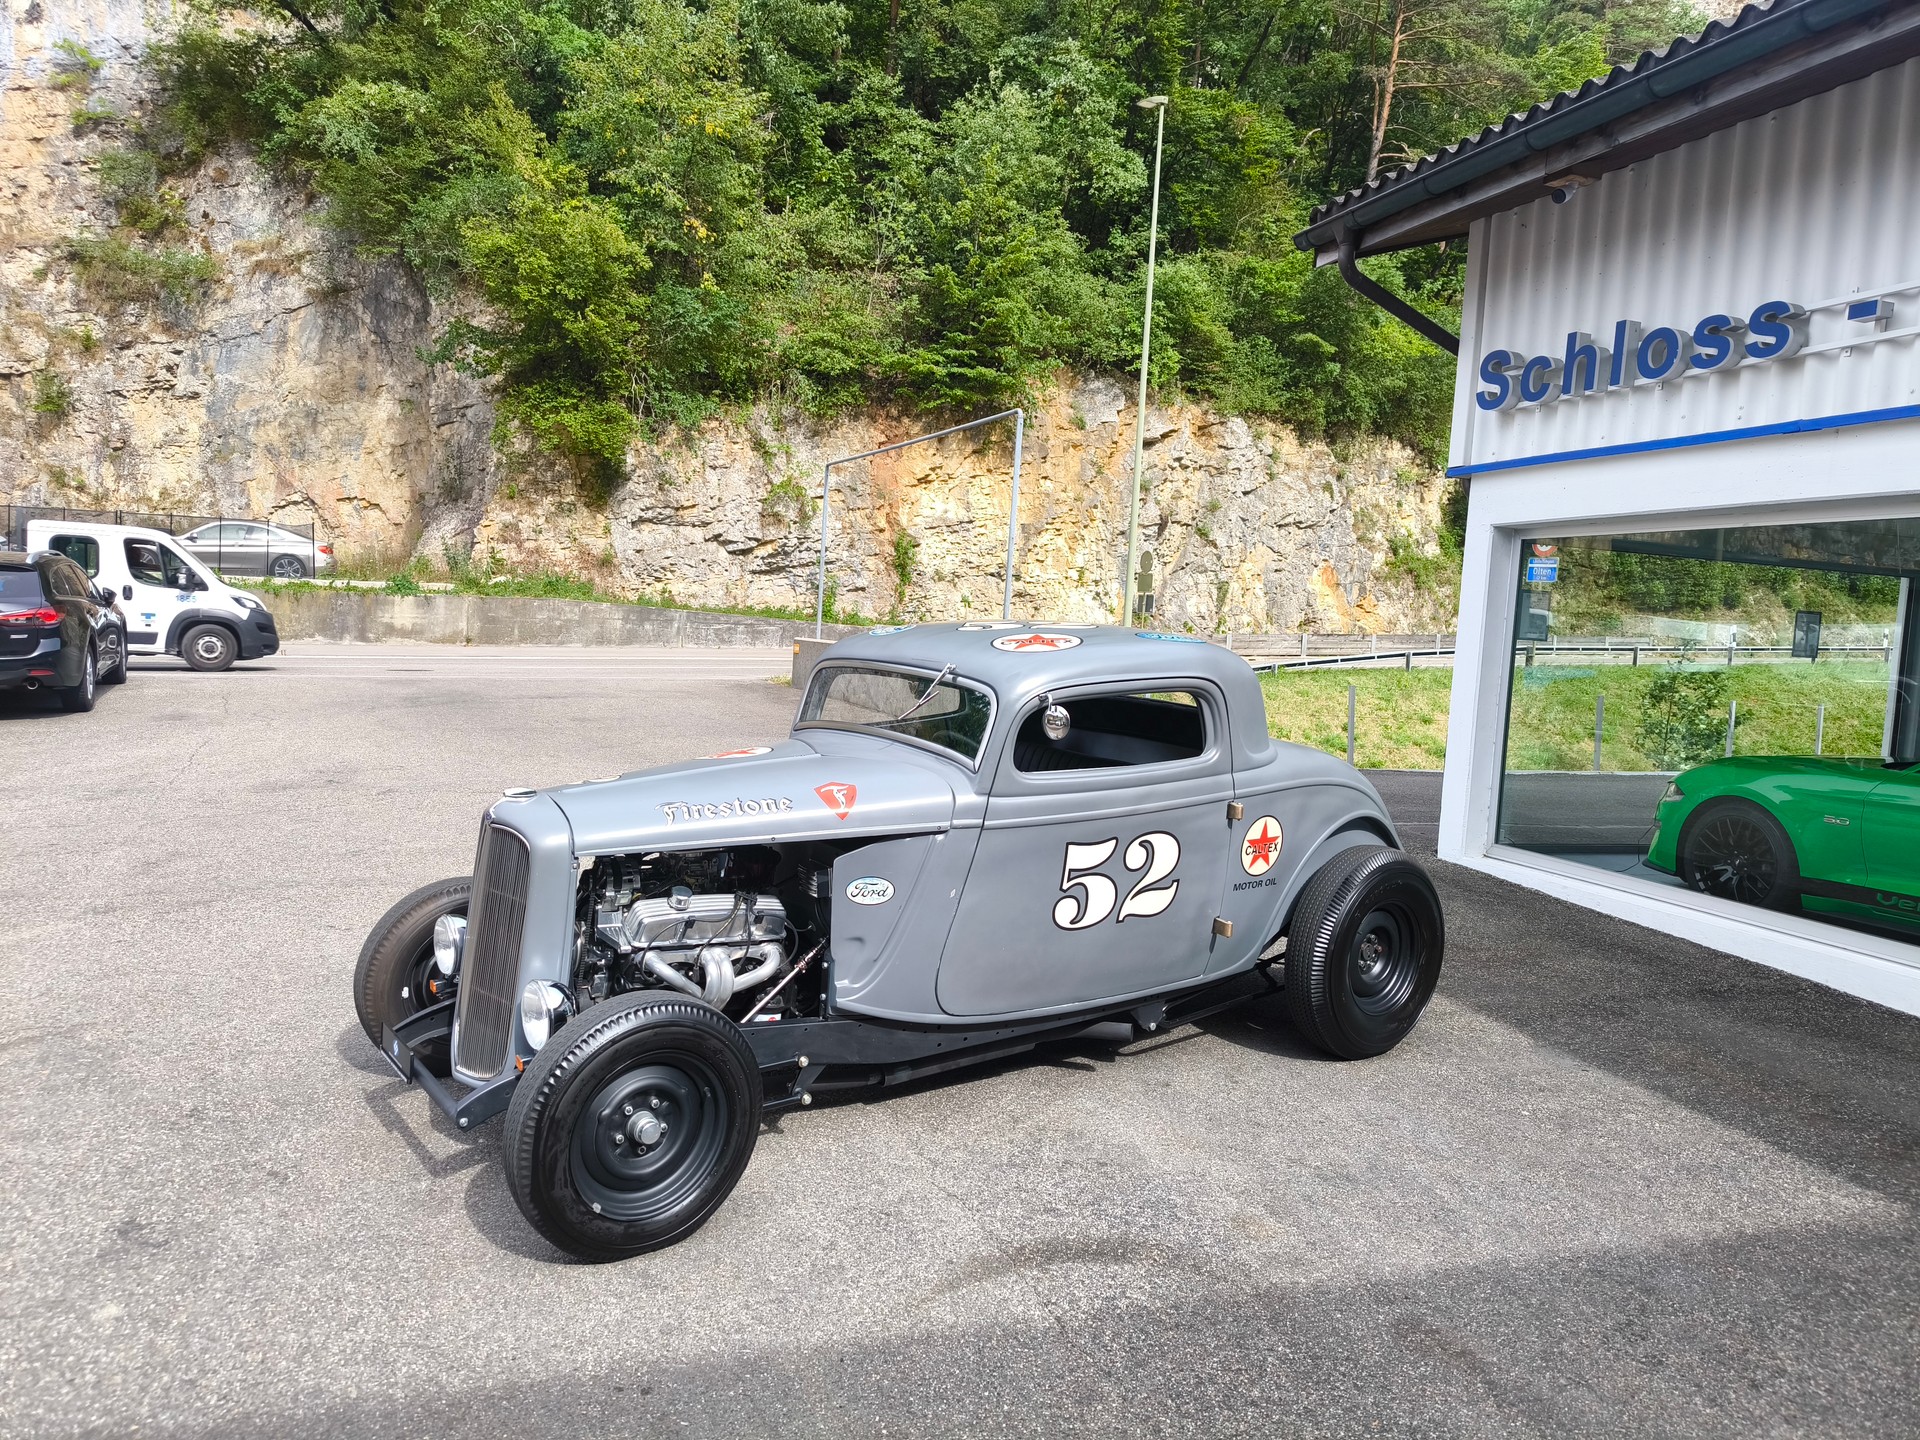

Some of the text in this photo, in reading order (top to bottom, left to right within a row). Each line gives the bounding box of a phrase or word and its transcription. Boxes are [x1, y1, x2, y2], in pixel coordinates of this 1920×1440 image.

[1475, 299, 1804, 412] Schloss
[1532, 566, 1552, 577] Olten
[1000, 638, 1074, 647] CALTEX
[655, 796, 794, 828] Firestone
[1245, 841, 1280, 856] CALTEX
[1052, 830, 1181, 931] 52
[1232, 877, 1278, 892] MOTOR OIL
[850, 882, 889, 898] Ford
